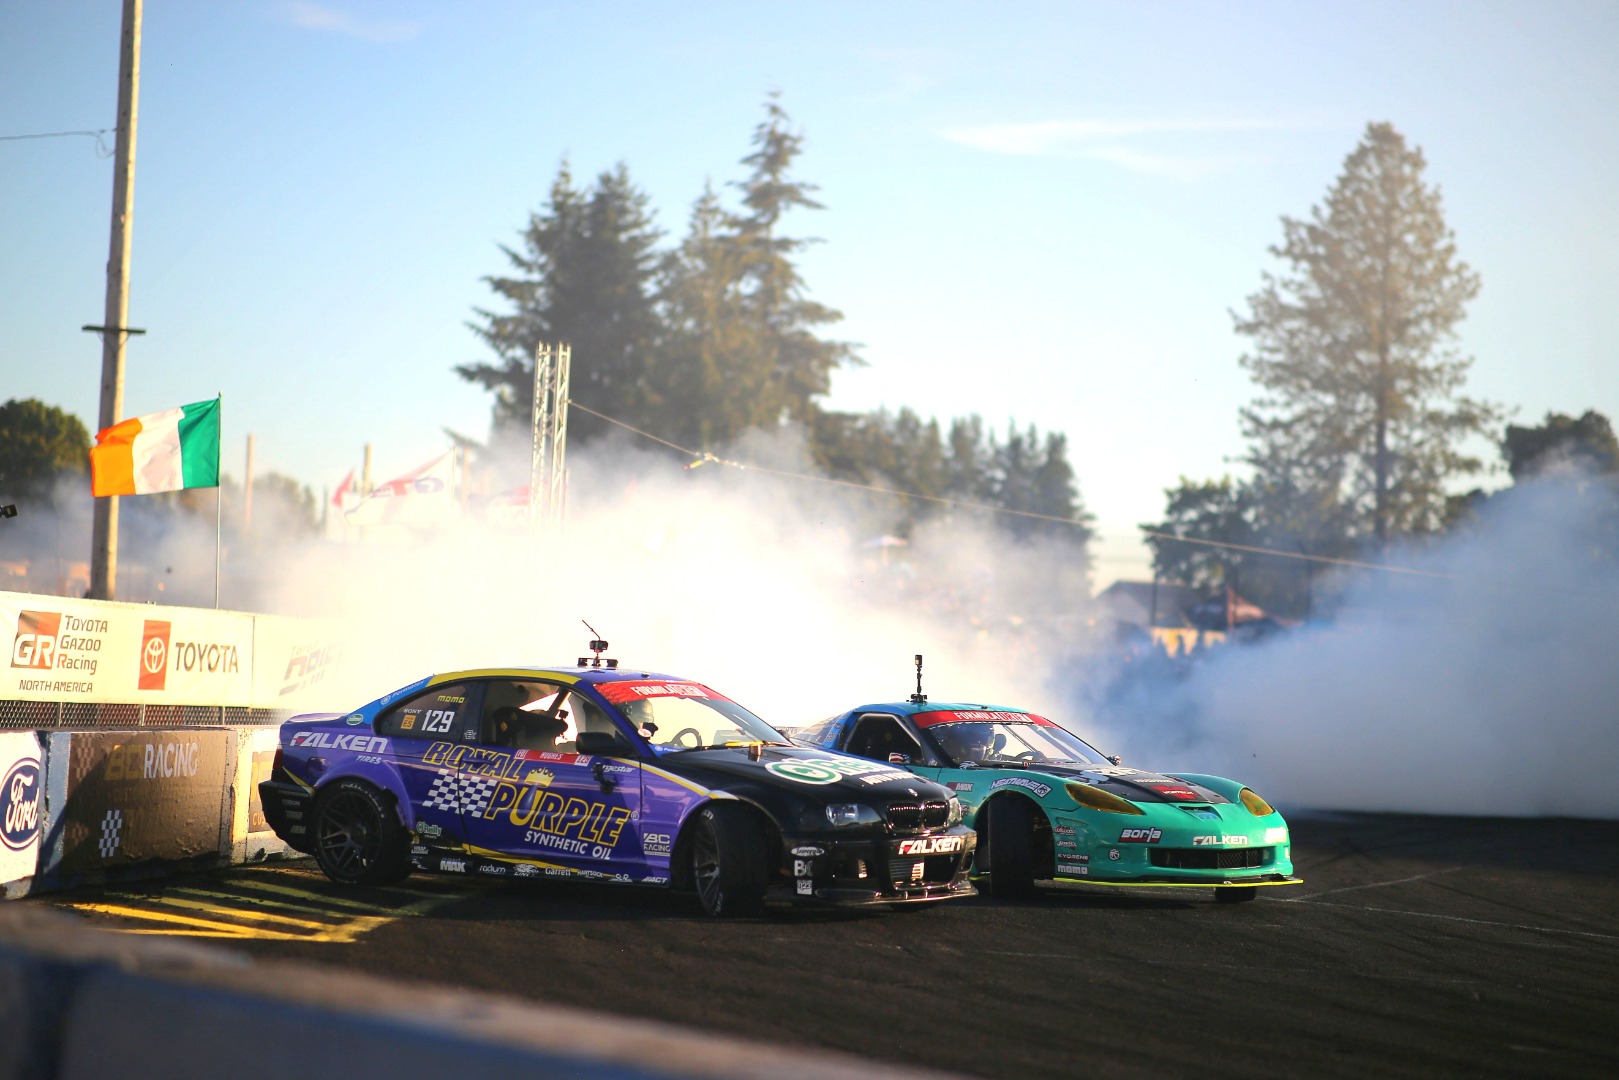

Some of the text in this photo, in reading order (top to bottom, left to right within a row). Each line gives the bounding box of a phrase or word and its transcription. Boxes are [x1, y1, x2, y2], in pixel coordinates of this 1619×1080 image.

[13, 634, 55, 667] GR
[175, 643, 238, 673] TOYOTA
[57, 653, 97, 675] Racing
[19, 680, 93, 693] NORTH AMERICA
[437, 695, 465, 704] momo
[421, 709, 455, 733] 129
[953, 711, 999, 721] FORMULA
[289, 731, 388, 754] FALKEN
[144, 742, 198, 778] RACING
[356, 754, 383, 765] TIRES
[422, 742, 526, 782] ROYAL
[540, 752, 564, 760] HUGHES
[6, 773, 39, 833] Ford
[484, 783, 631, 847] PURPLE
[524, 830, 612, 861] SYNTHETIC OIL
[644, 844, 670, 852] RACING
[898, 838, 961, 855] FALKEN
[1193, 835, 1248, 846] FALKEN
[545, 866, 571, 876] Garrett
